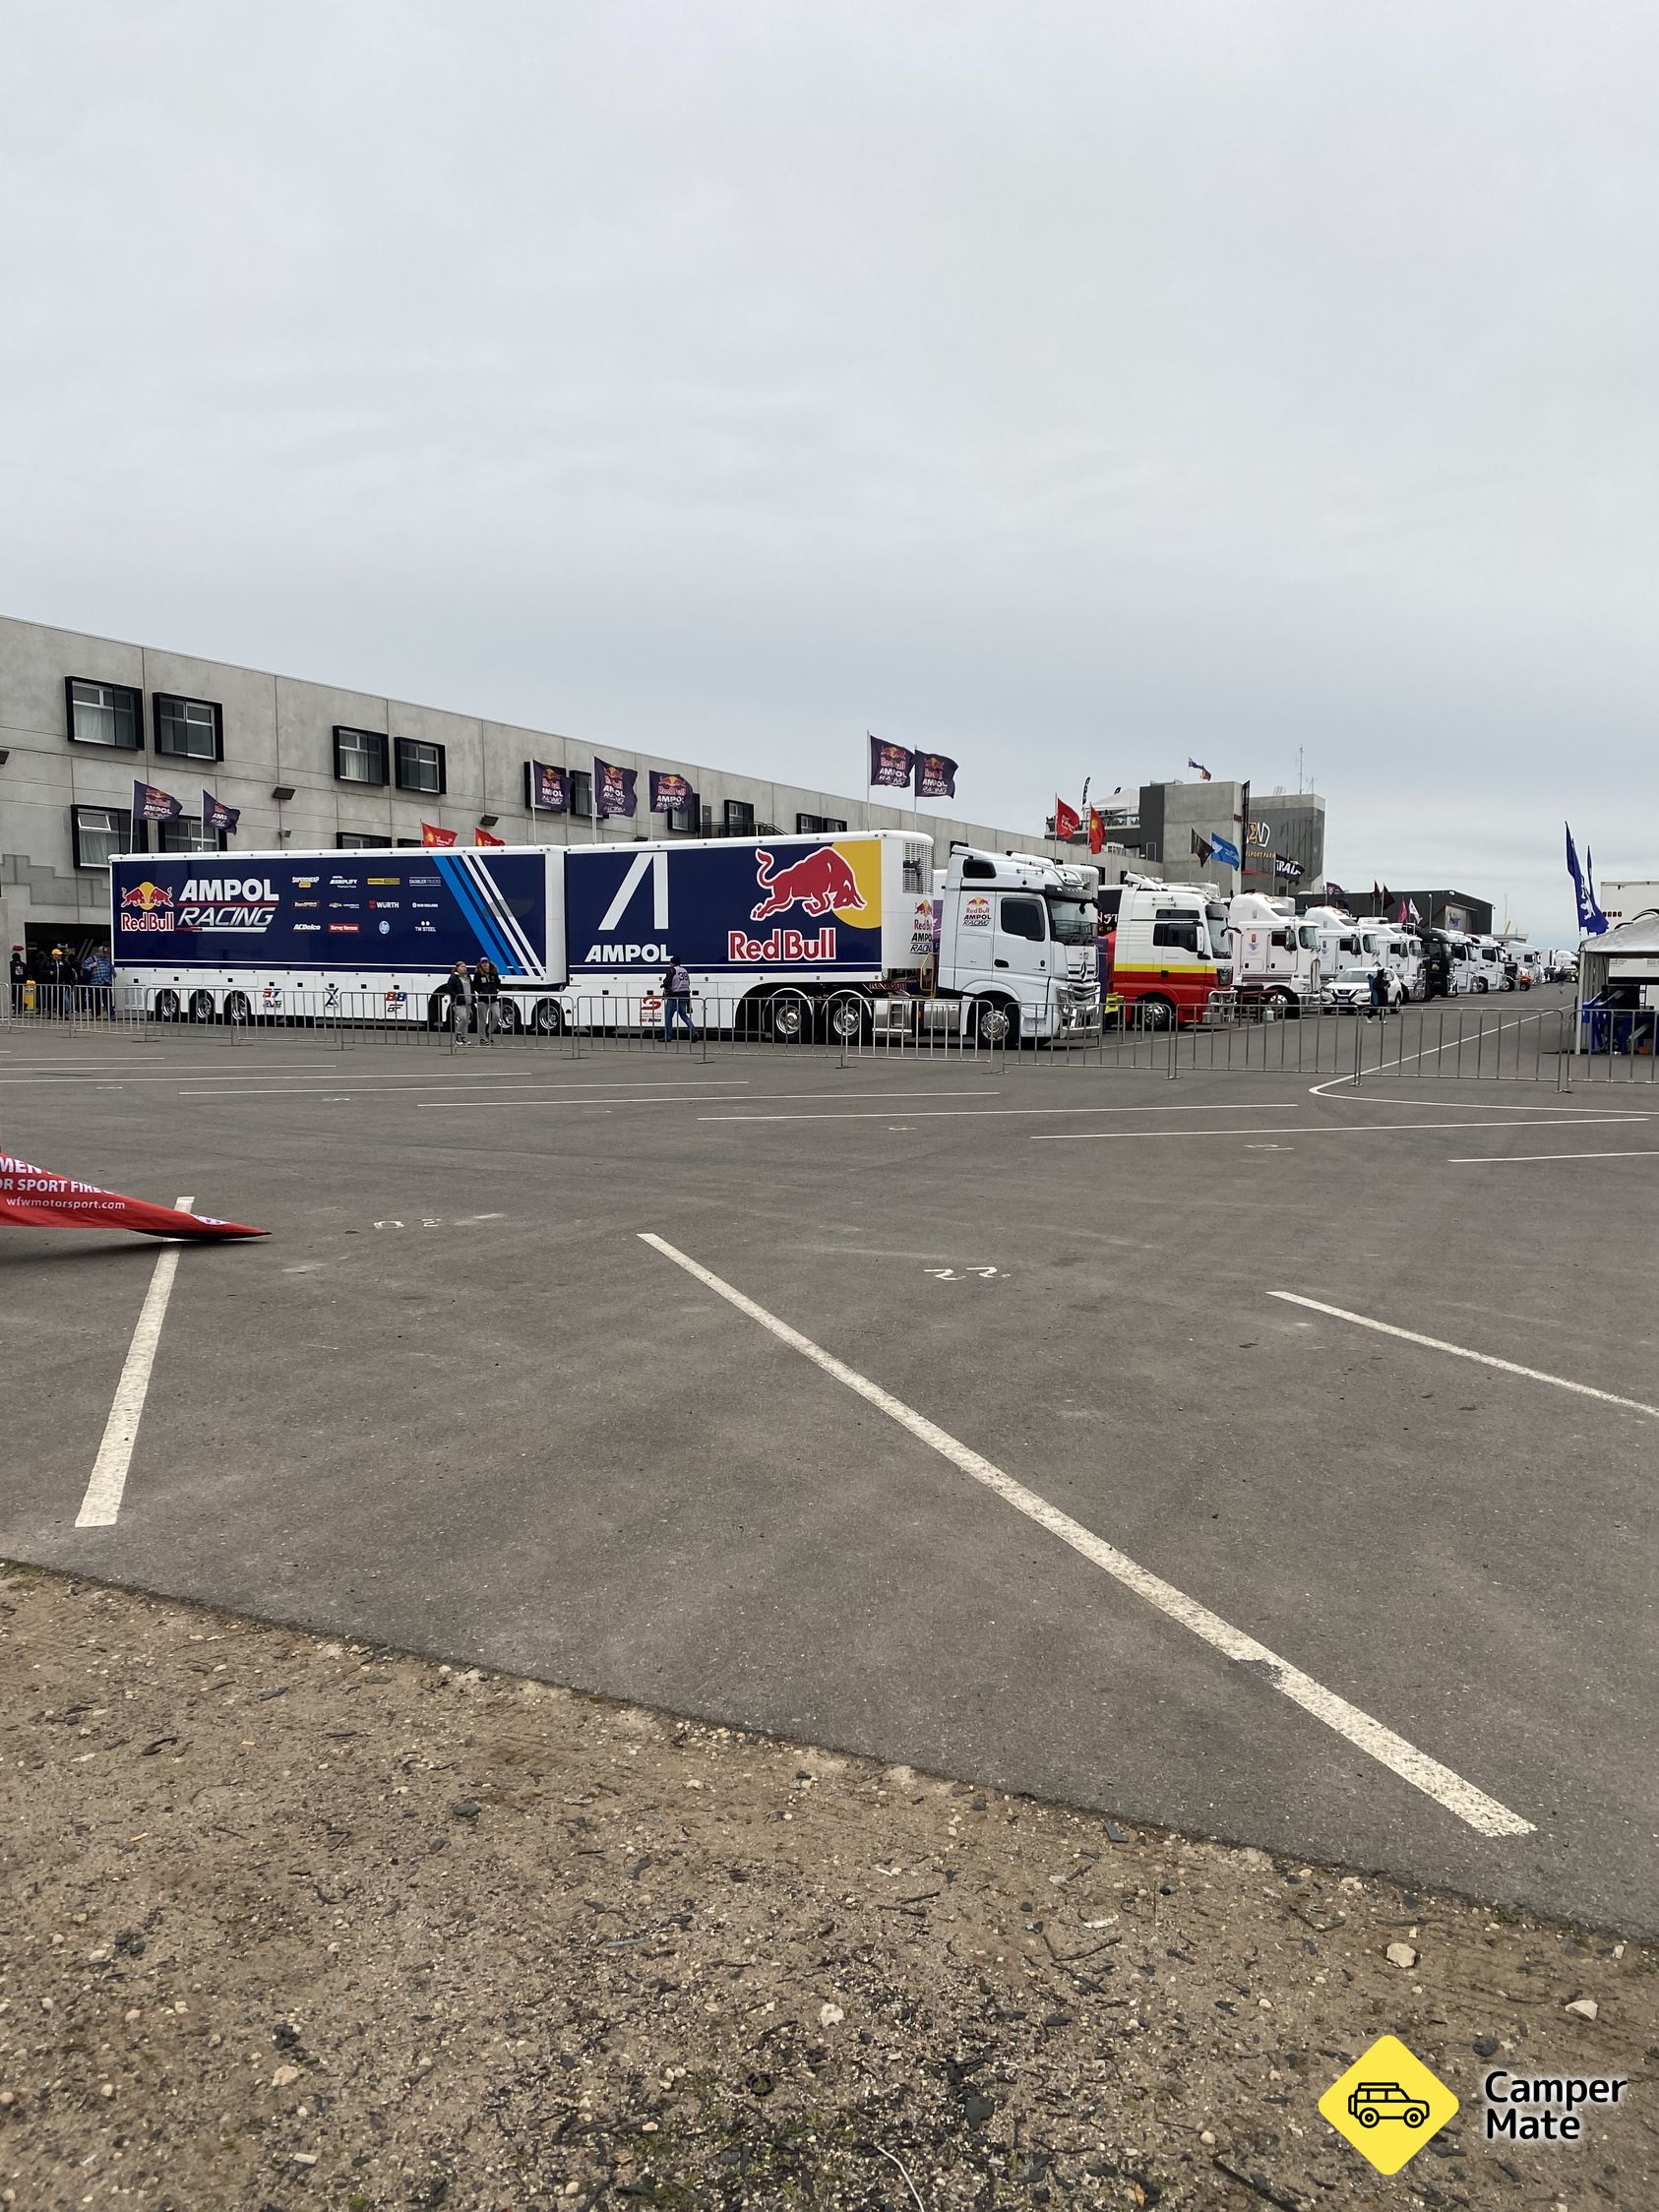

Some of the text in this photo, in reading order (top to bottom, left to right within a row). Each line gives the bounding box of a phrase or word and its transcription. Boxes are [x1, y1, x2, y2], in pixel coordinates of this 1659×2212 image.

[144, 804, 172, 815] AMPOL
[178, 878, 280, 902] AMPOL
[176, 906, 276, 927] RACING
[911, 932, 933, 943] AMPO
[584, 943, 675, 963] AMPOL
[18, 1178, 68, 1193] SPORT
[7, 1197, 125, 1210] wfwmotorsport.com
